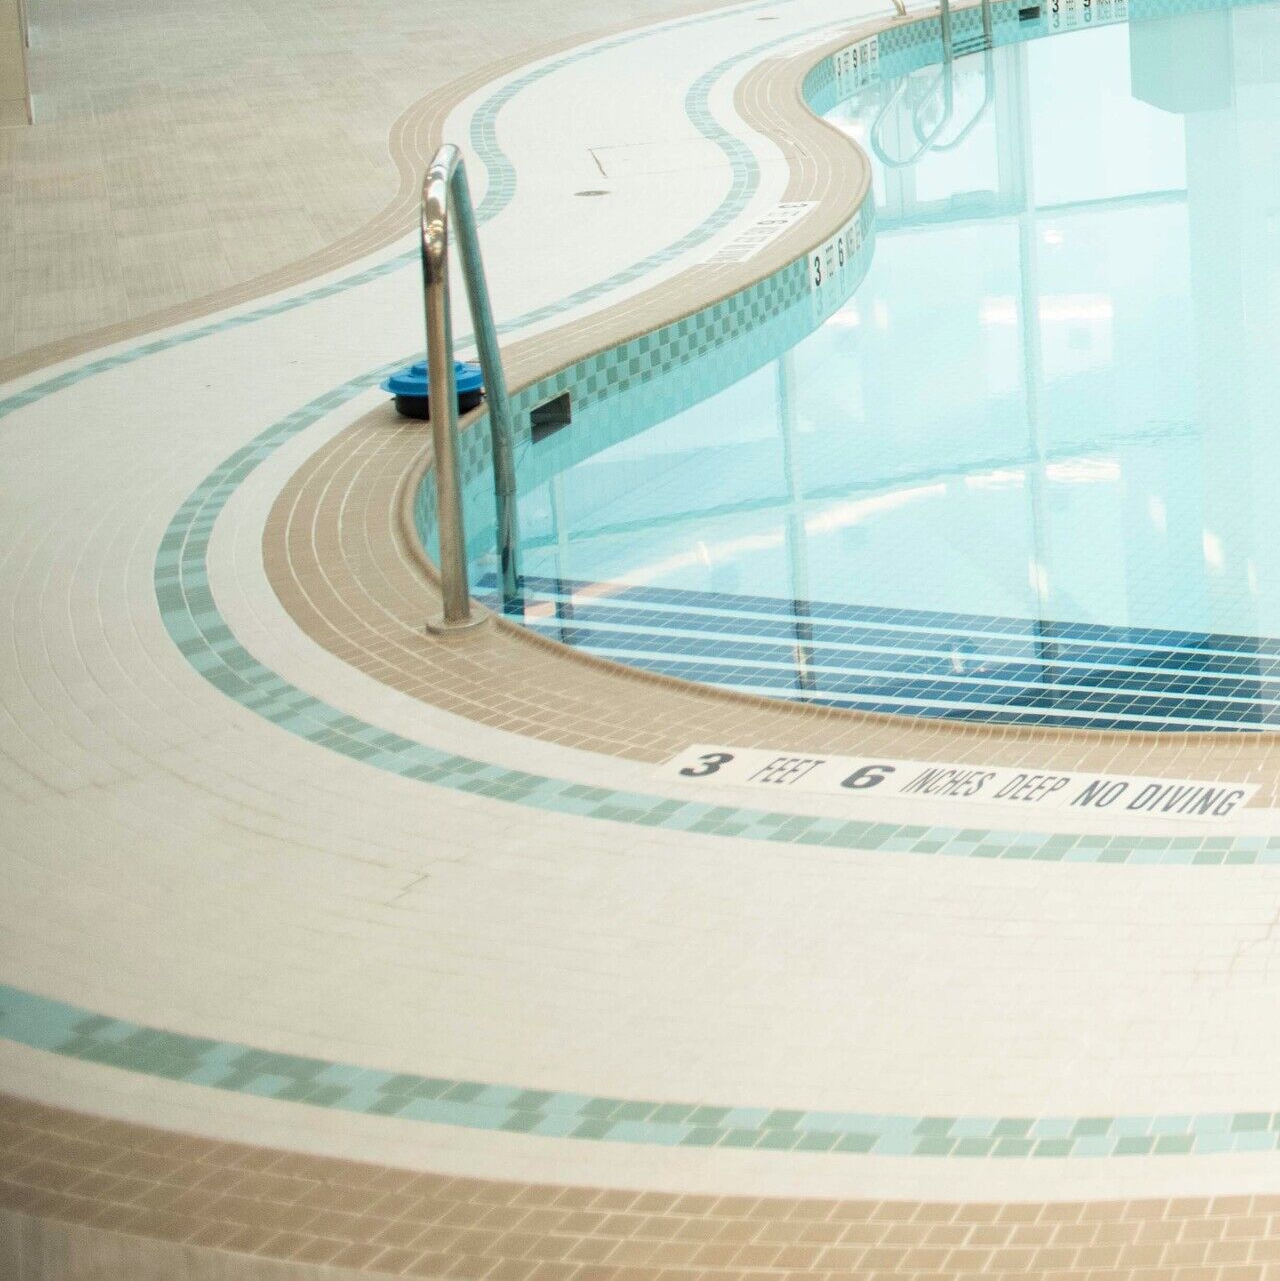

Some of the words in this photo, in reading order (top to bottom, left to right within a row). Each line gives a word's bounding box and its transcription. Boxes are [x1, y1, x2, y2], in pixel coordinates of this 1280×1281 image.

[814, 255, 821, 286] 3
[838, 237, 844, 267] 6
[679, 753, 734, 776] 3
[748, 757, 825, 784] FEET
[840, 765, 896, 789] 6
[899, 767, 996, 797] INCHES
[993, 773, 1071, 802] DEEP
[1070, 779, 1130, 807] NO
[1125, 783, 1246, 816] DIVING
